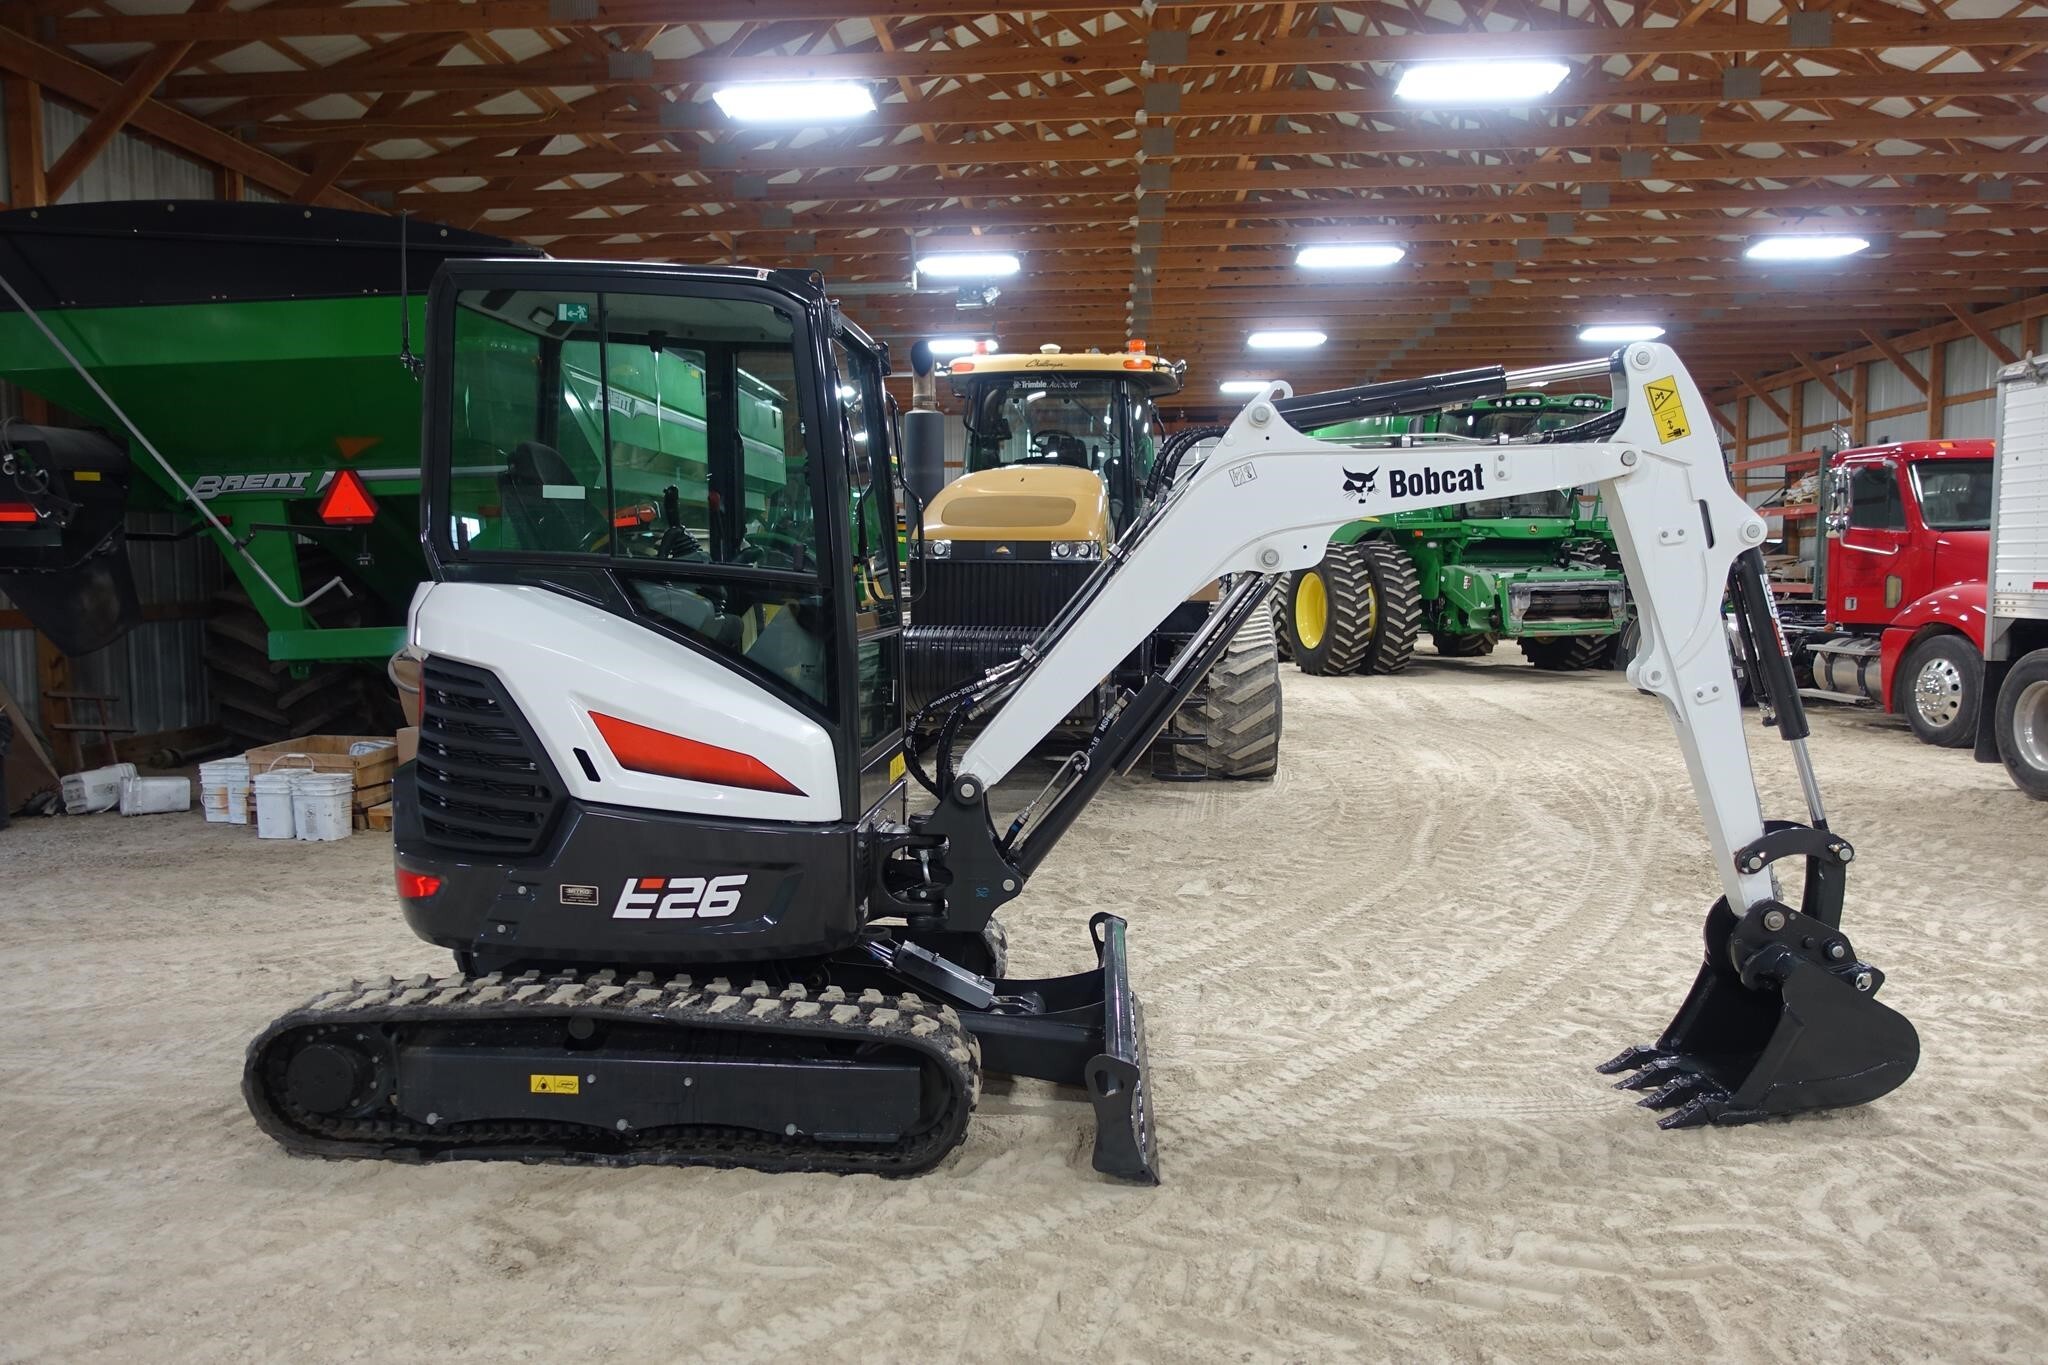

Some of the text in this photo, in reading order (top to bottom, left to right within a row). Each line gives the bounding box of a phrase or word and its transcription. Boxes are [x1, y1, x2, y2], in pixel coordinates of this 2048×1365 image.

[1021, 380, 1047, 389] Trimble
[186, 472, 312, 500] BRENT
[1389, 463, 1484, 498] Bobcat
[612, 874, 749, 919] E26
